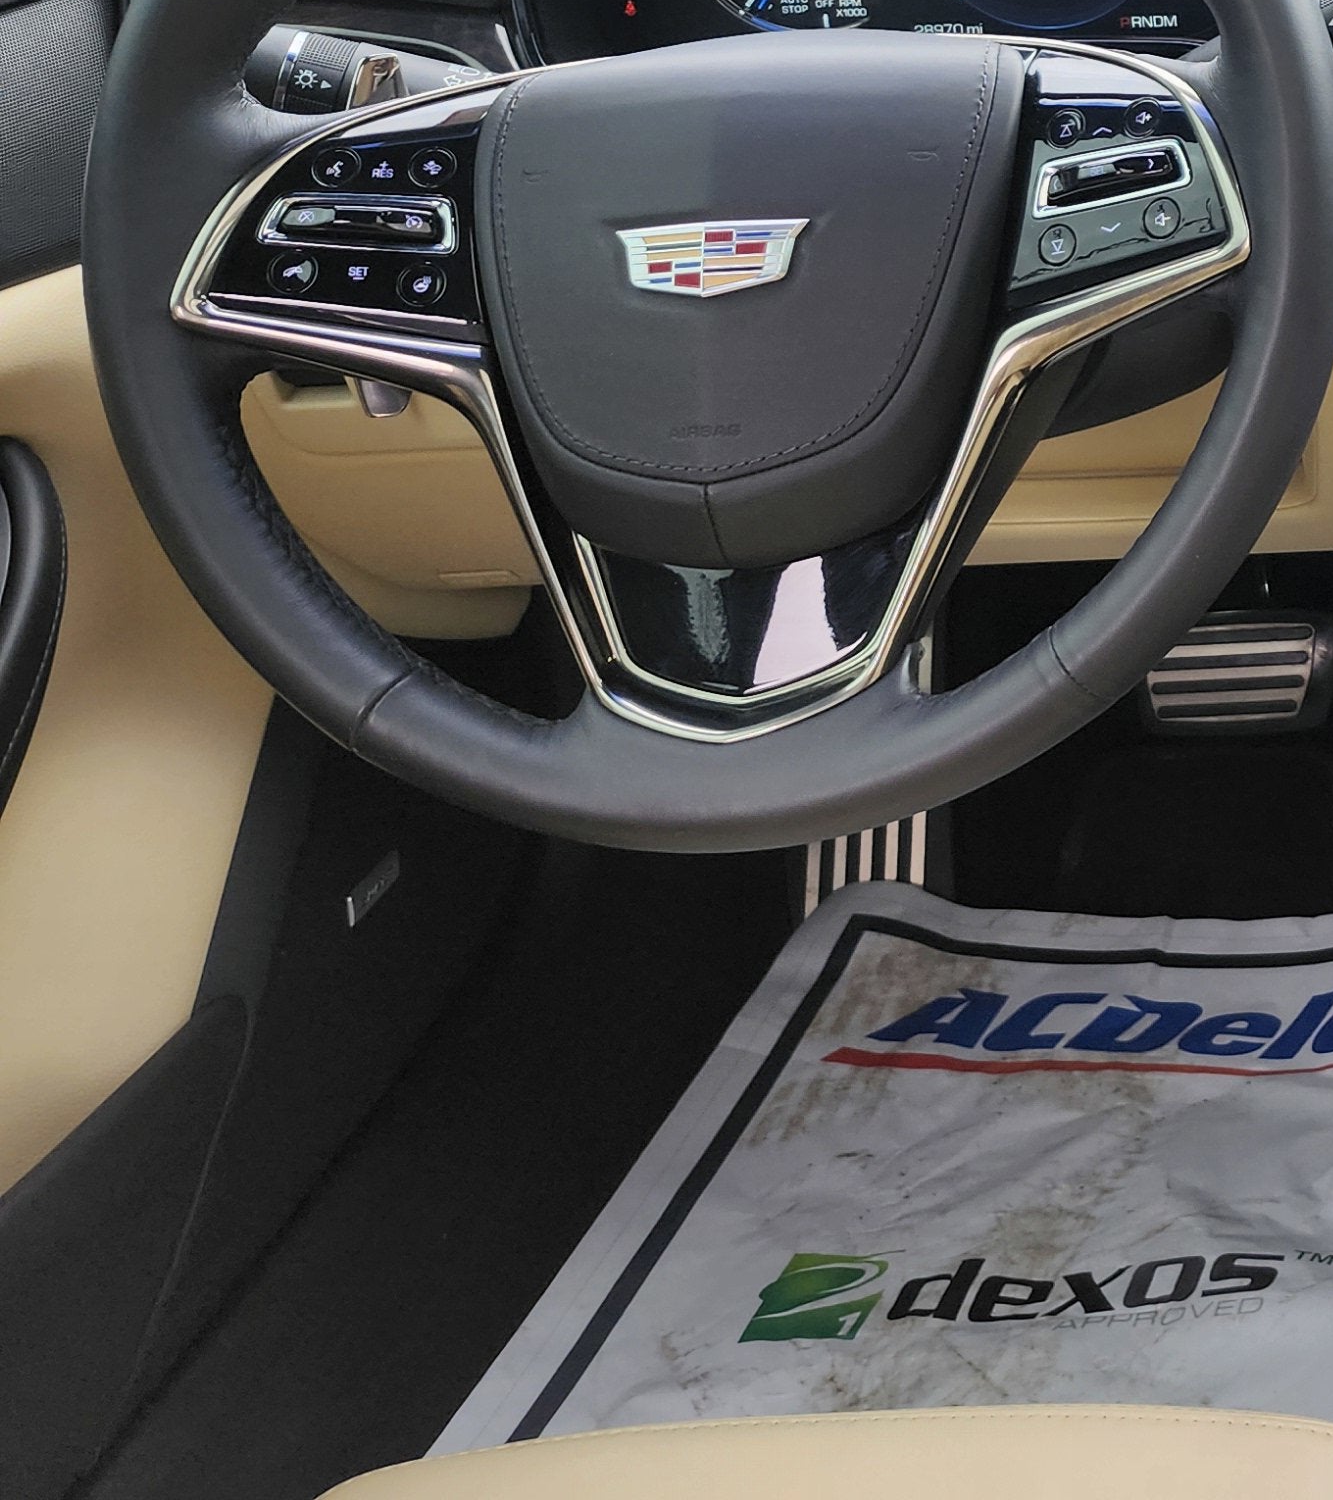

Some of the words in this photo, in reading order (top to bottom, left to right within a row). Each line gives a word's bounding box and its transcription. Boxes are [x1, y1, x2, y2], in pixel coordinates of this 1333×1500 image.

[781, 4, 808, 14] STOP
[815, 0, 834, 8] OFF
[835, 7, 867, 17] X1000
[965, 23, 983, 34] mi
[371, 168, 394, 178] RES
[348, 267, 369, 277] SET
[887, 1251, 1285, 1322] dexos
[1052, 1296, 1264, 1332] APPROVED
[836, 1313, 855, 1337] 1
